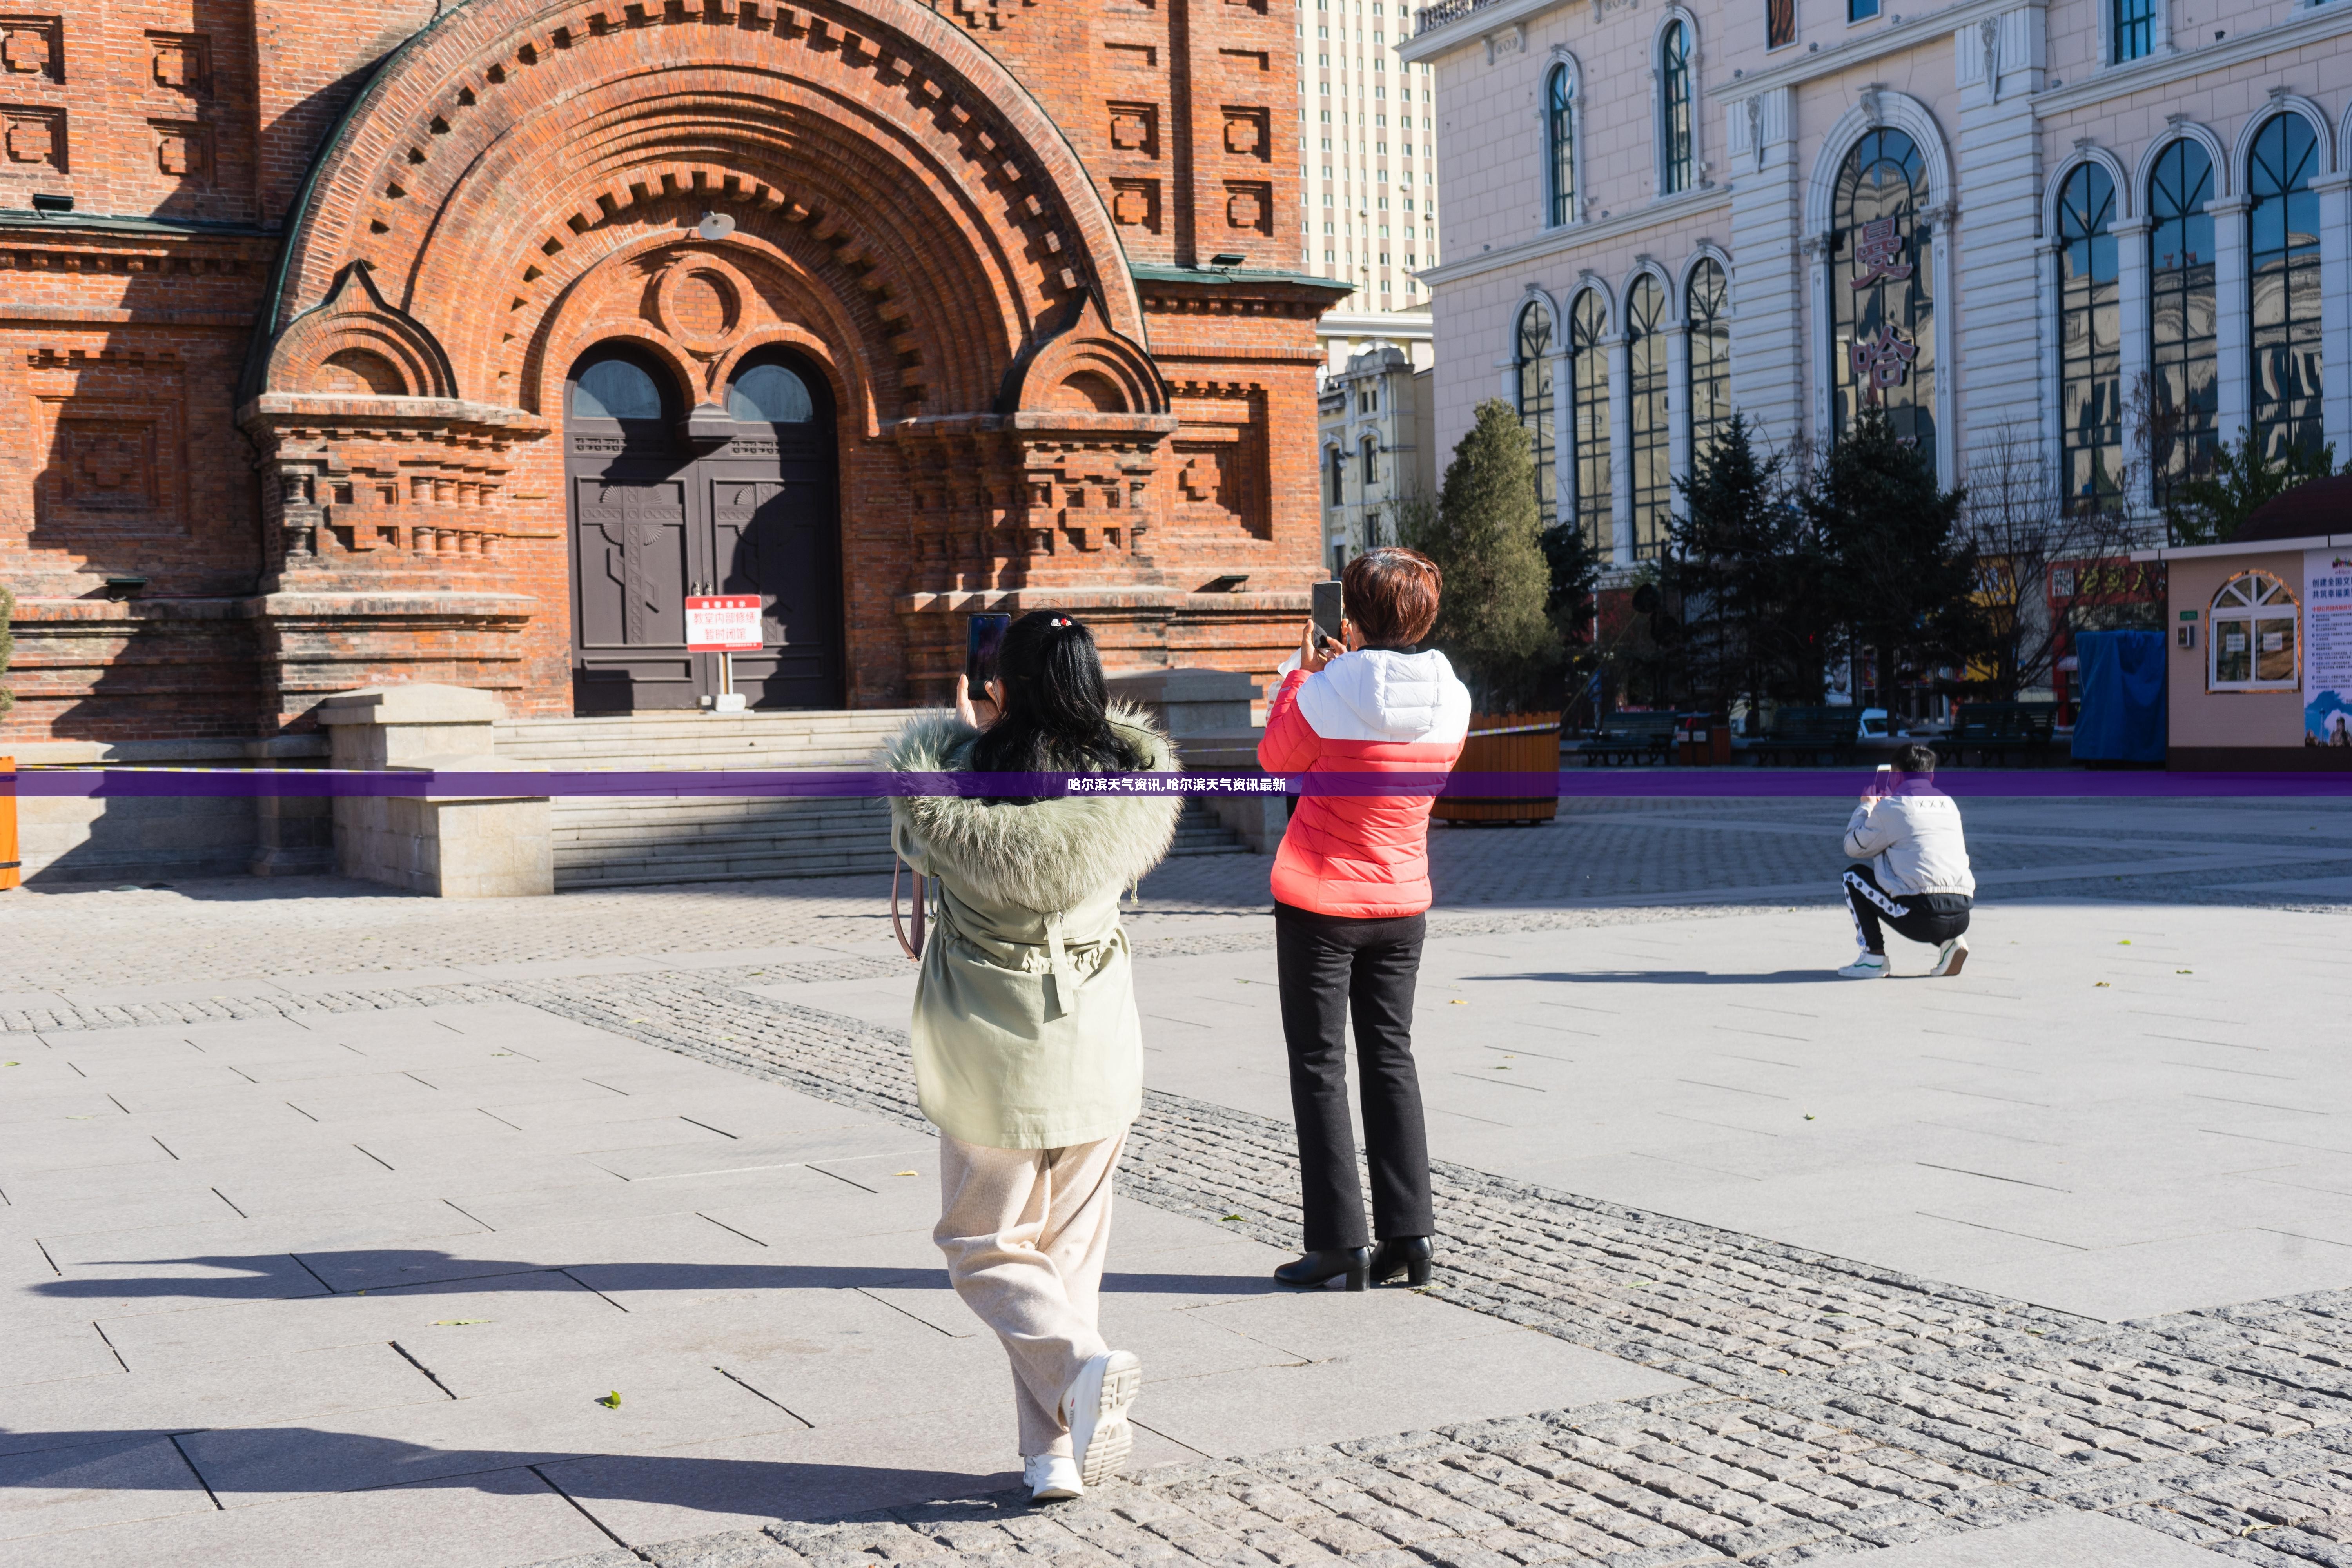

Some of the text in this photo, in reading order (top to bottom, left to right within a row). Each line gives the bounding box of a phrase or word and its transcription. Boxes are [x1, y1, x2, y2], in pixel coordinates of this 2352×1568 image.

[1850, 216, 1916, 449] 曼哈
[2312, 577, 2352, 588] 创建全国文
[2313, 588, 2352, 599] 共筑幸福美
[693, 611, 756, 625] 教堂内部修缮
[705, 628, 746, 641] 暂时闭馆
